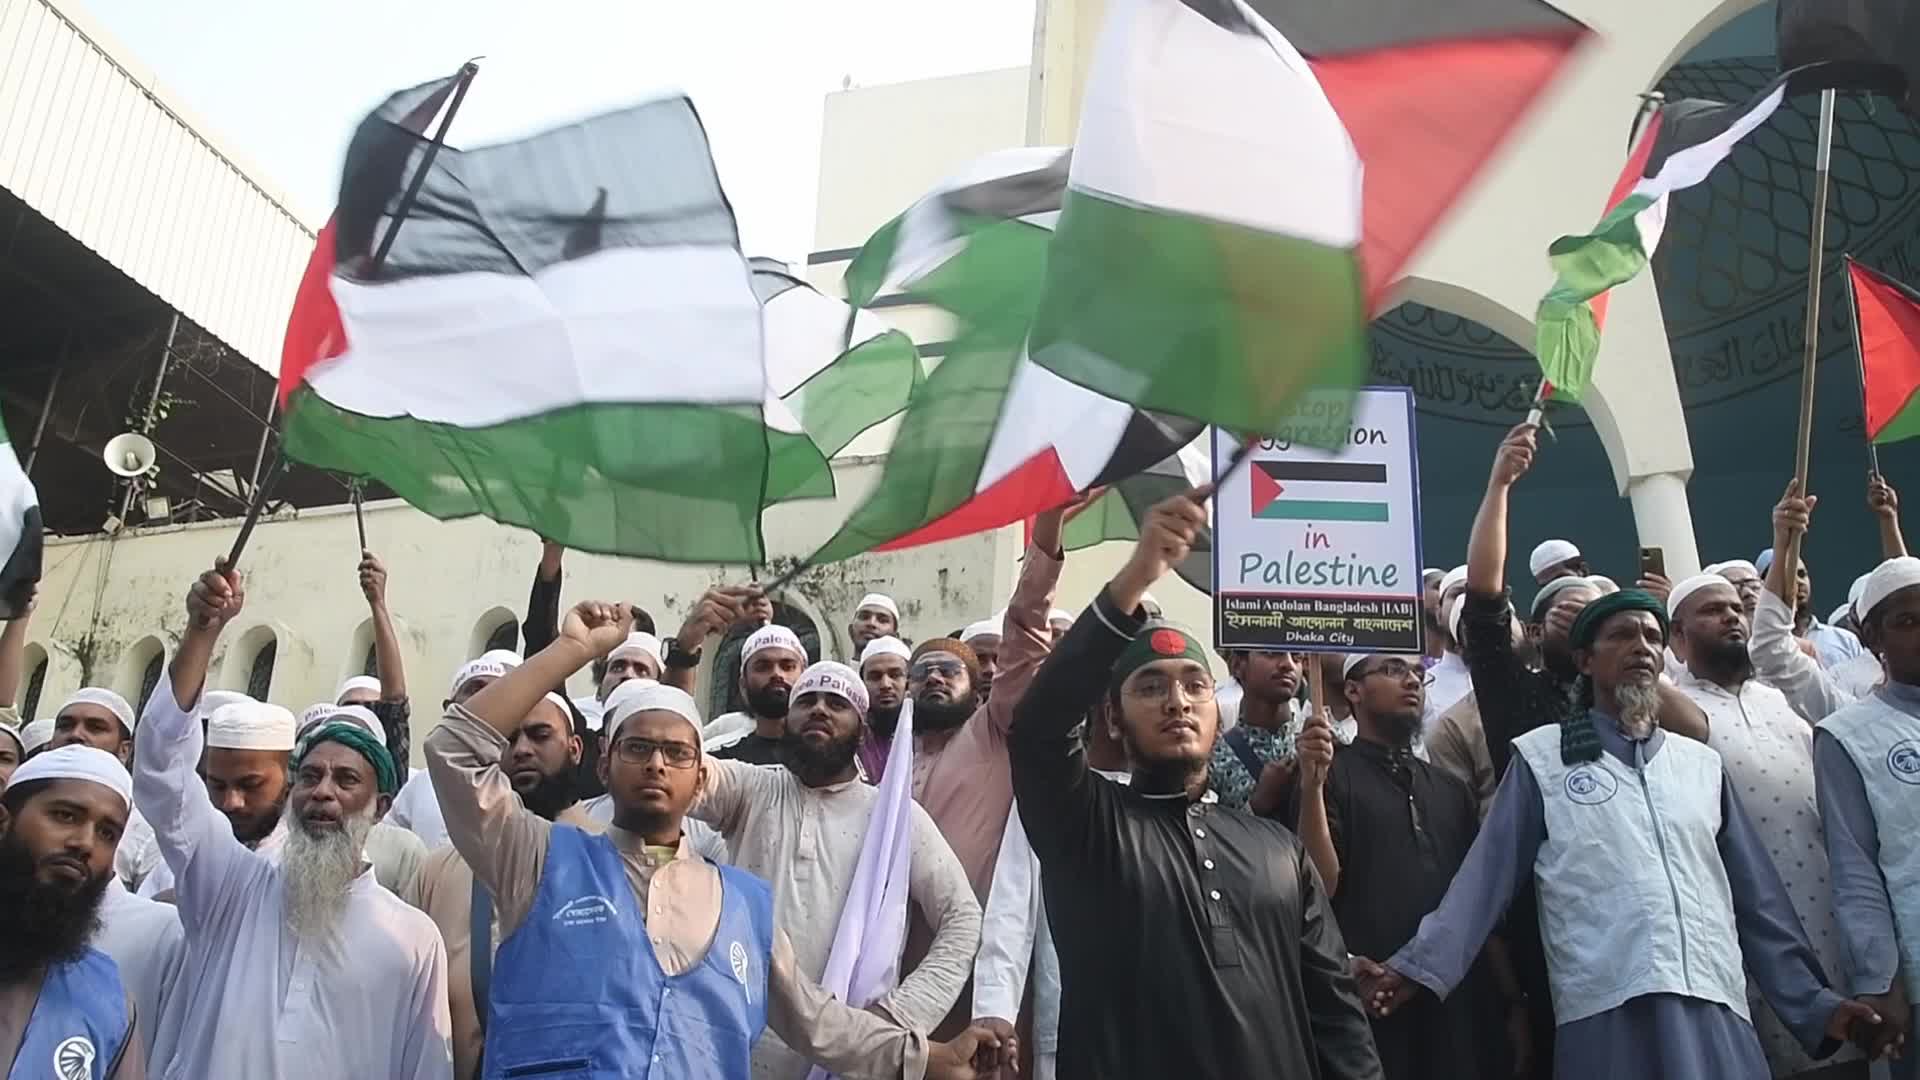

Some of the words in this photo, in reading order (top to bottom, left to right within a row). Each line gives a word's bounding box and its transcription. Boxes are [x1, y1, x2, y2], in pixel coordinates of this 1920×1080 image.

[1304, 522, 1331, 550] in
[1239, 549, 1399, 588] Palestine
[1225, 598, 1261, 611] Islami
[1263, 600, 1311, 612] Andolan
[1314, 600, 1379, 615] Bangladesh
[1224, 611, 1284, 629] ইসলামী
[1286, 614, 1348, 630] আন্দোলন
[1352, 617, 1415, 633] বাংলাদেশ
[1285, 630, 1325, 643] Dhaka
[1328, 631, 1355, 646] City
